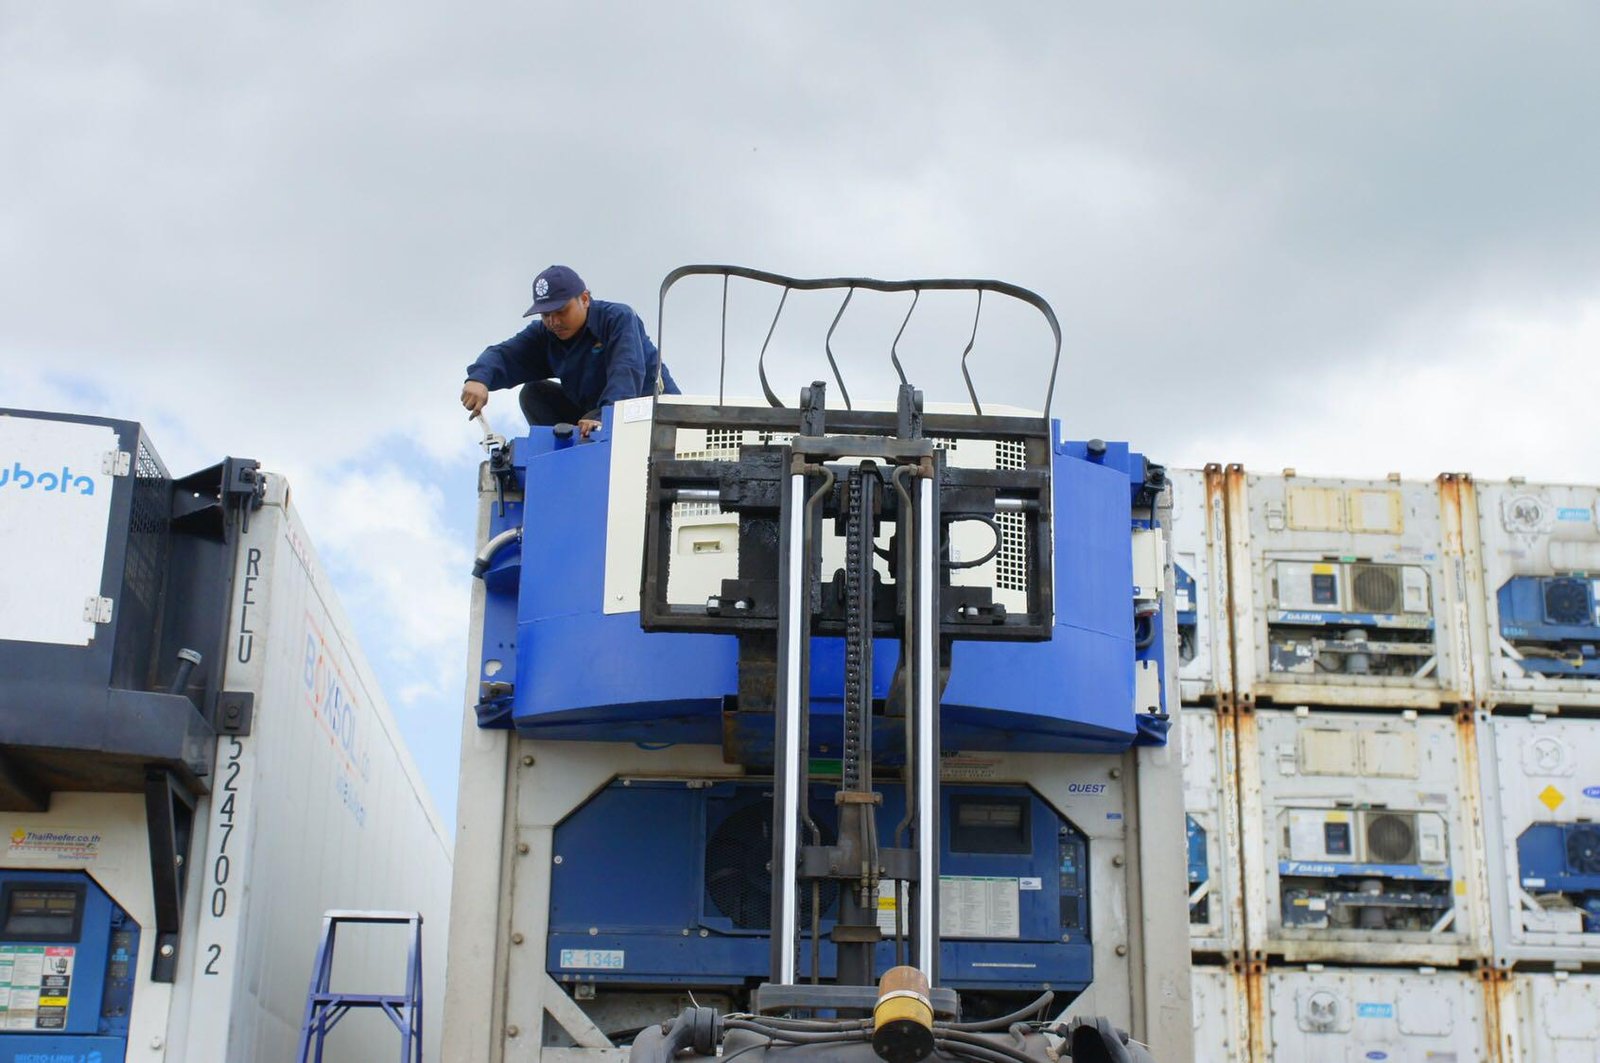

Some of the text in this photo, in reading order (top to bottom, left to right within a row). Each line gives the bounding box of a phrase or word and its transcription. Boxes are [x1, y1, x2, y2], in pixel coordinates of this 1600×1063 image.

[1287, 613, 1325, 622] DAIKIN
[205, 548, 261, 975] RELU 524700 2
[1068, 783, 1106, 793] QUEST
[26, 831, 101, 843] ThaiReefer.co.th
